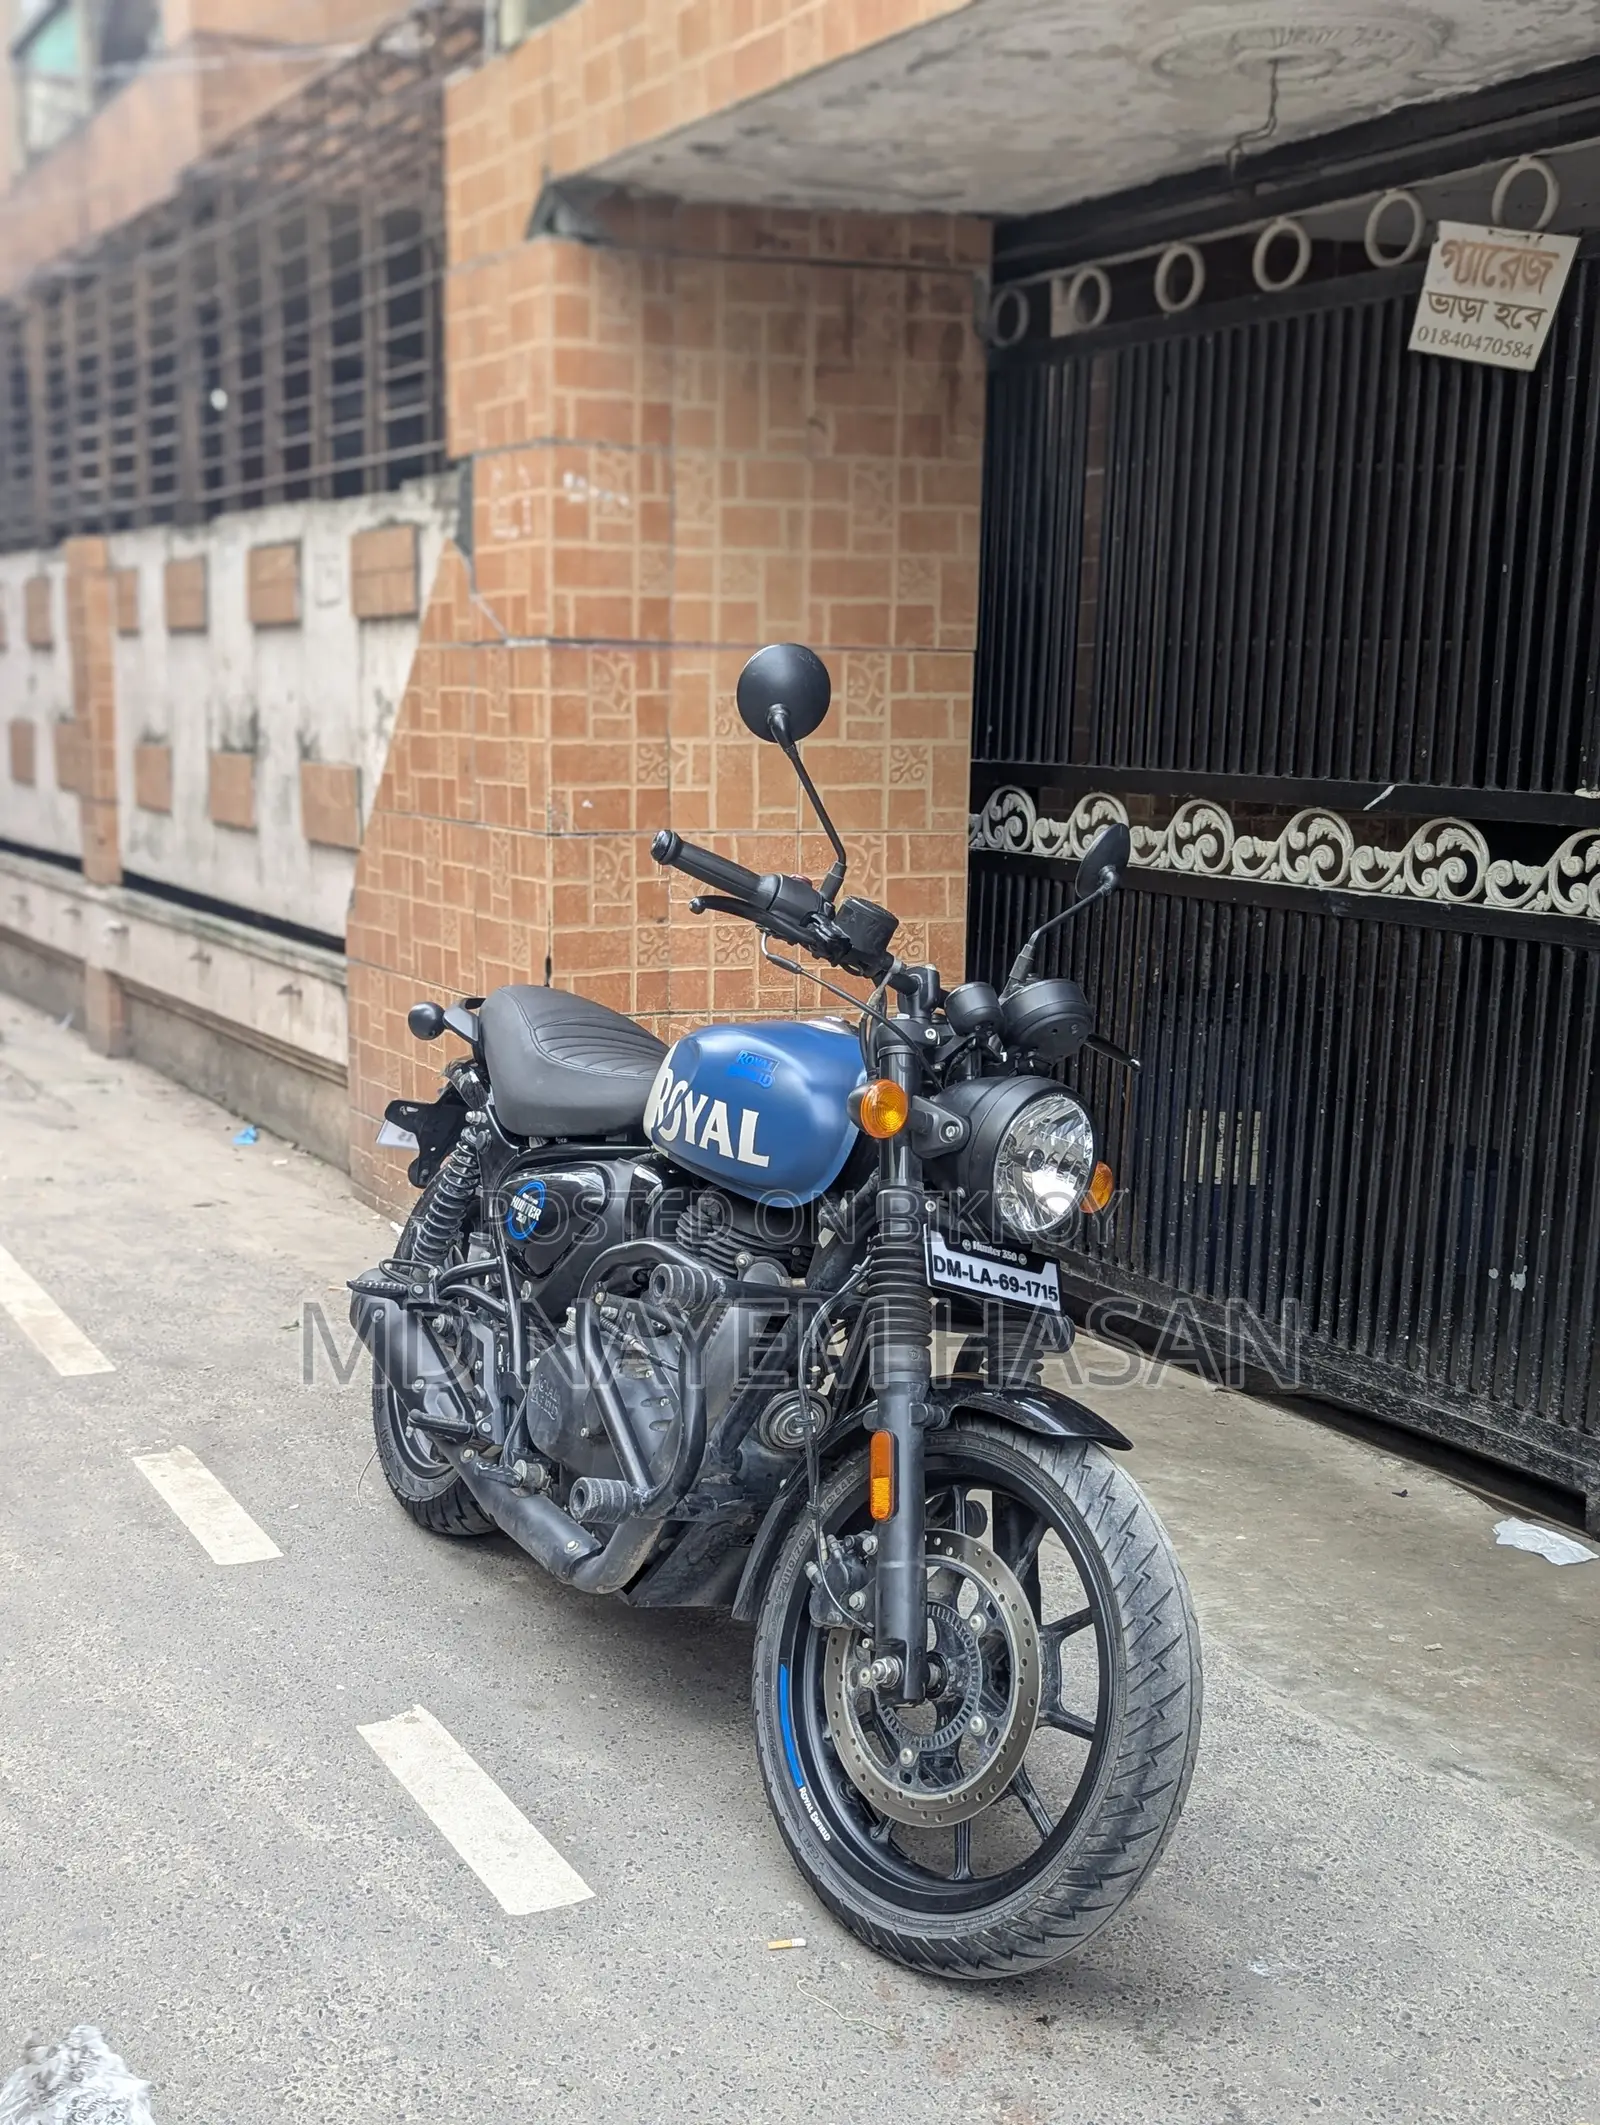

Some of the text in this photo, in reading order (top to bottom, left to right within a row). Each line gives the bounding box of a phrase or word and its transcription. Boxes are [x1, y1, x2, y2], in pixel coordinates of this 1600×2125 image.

[1440, 239, 1560, 294] গ্যারেজ
[1426, 291, 1548, 333] ভাড়া হবে
[1417, 325, 1534, 360] 01840470584
[650, 1067, 770, 1168] ROYAL
[510, 1195, 542, 1221] HUNTER
[1001, 1249, 1018, 1262] 350
[933, 1254, 1059, 1302] DM-LA-69-1715
[799, 1786, 814, 1813] ROYAL
